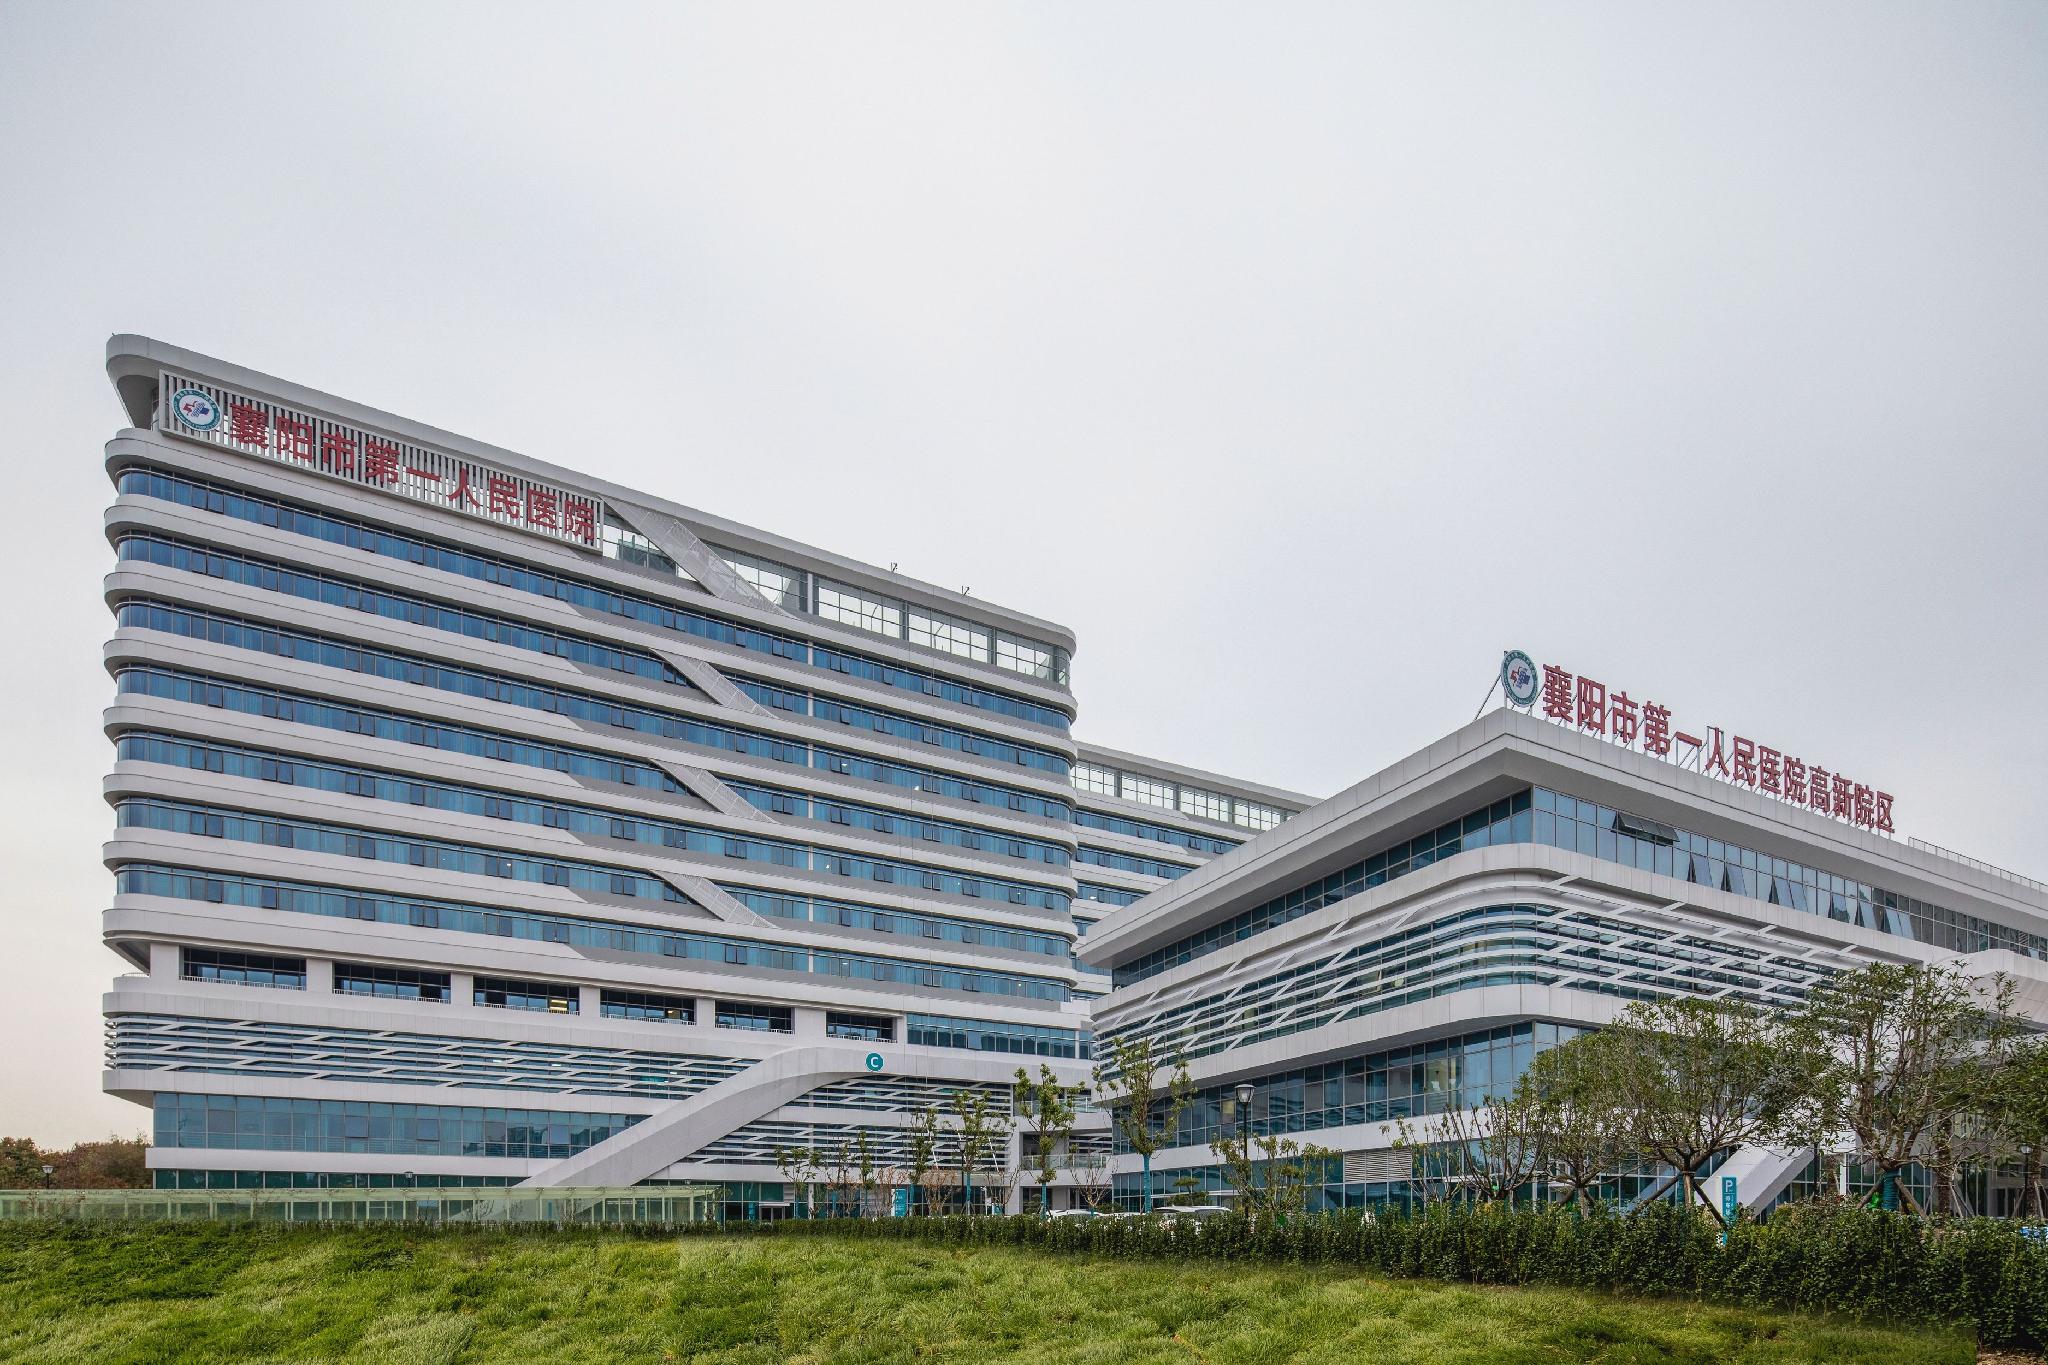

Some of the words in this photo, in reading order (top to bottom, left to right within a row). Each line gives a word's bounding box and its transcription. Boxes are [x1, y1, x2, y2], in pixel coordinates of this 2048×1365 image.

[230, 403, 595, 541] 襄阳市第一人民医院
[1543, 664, 1895, 833] 襄阳市第一人民医院高新院区
[870, 1056, 879, 1068] C
[1725, 1179, 1733, 1193] P
